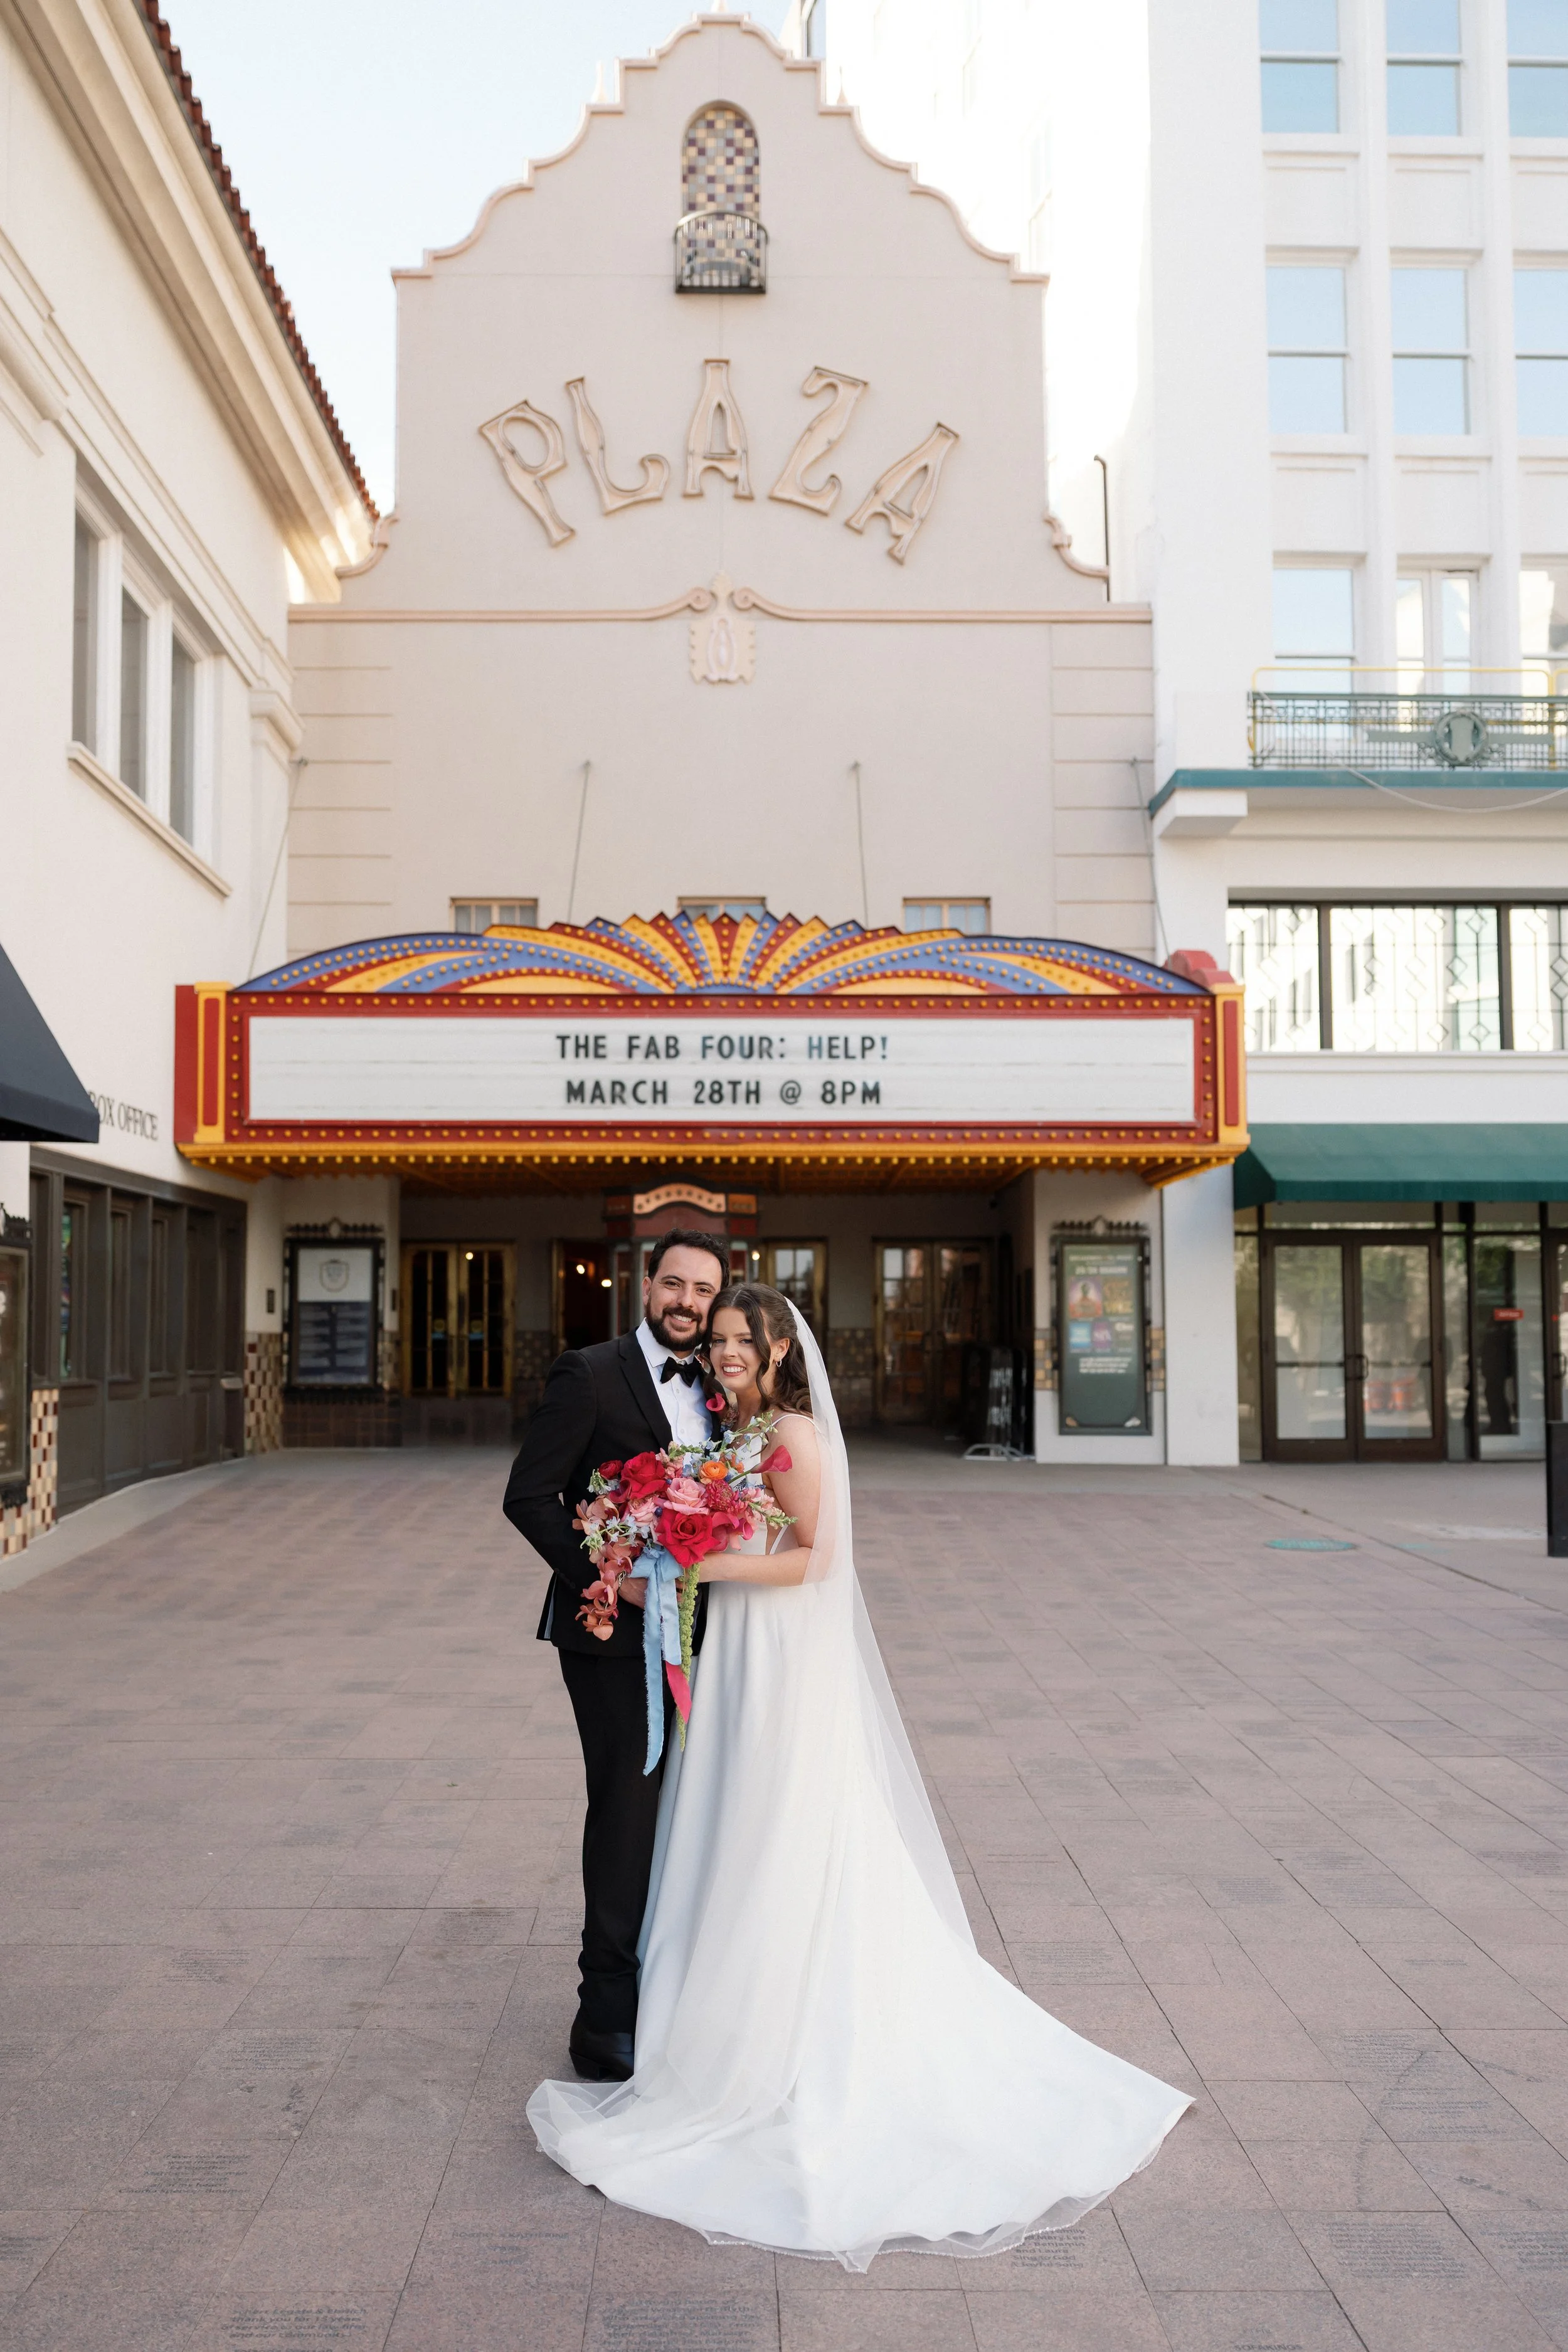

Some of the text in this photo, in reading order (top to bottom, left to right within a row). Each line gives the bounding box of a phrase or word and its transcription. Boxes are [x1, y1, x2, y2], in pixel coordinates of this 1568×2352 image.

[479, 359, 960, 565] PLAZA
[556, 1035, 888, 1059] THE FAB FOUR: HELP!
[567, 1080, 881, 1104] MARCH 28TH @ 8PM
[117, 1102, 158, 1141] OFFICE
